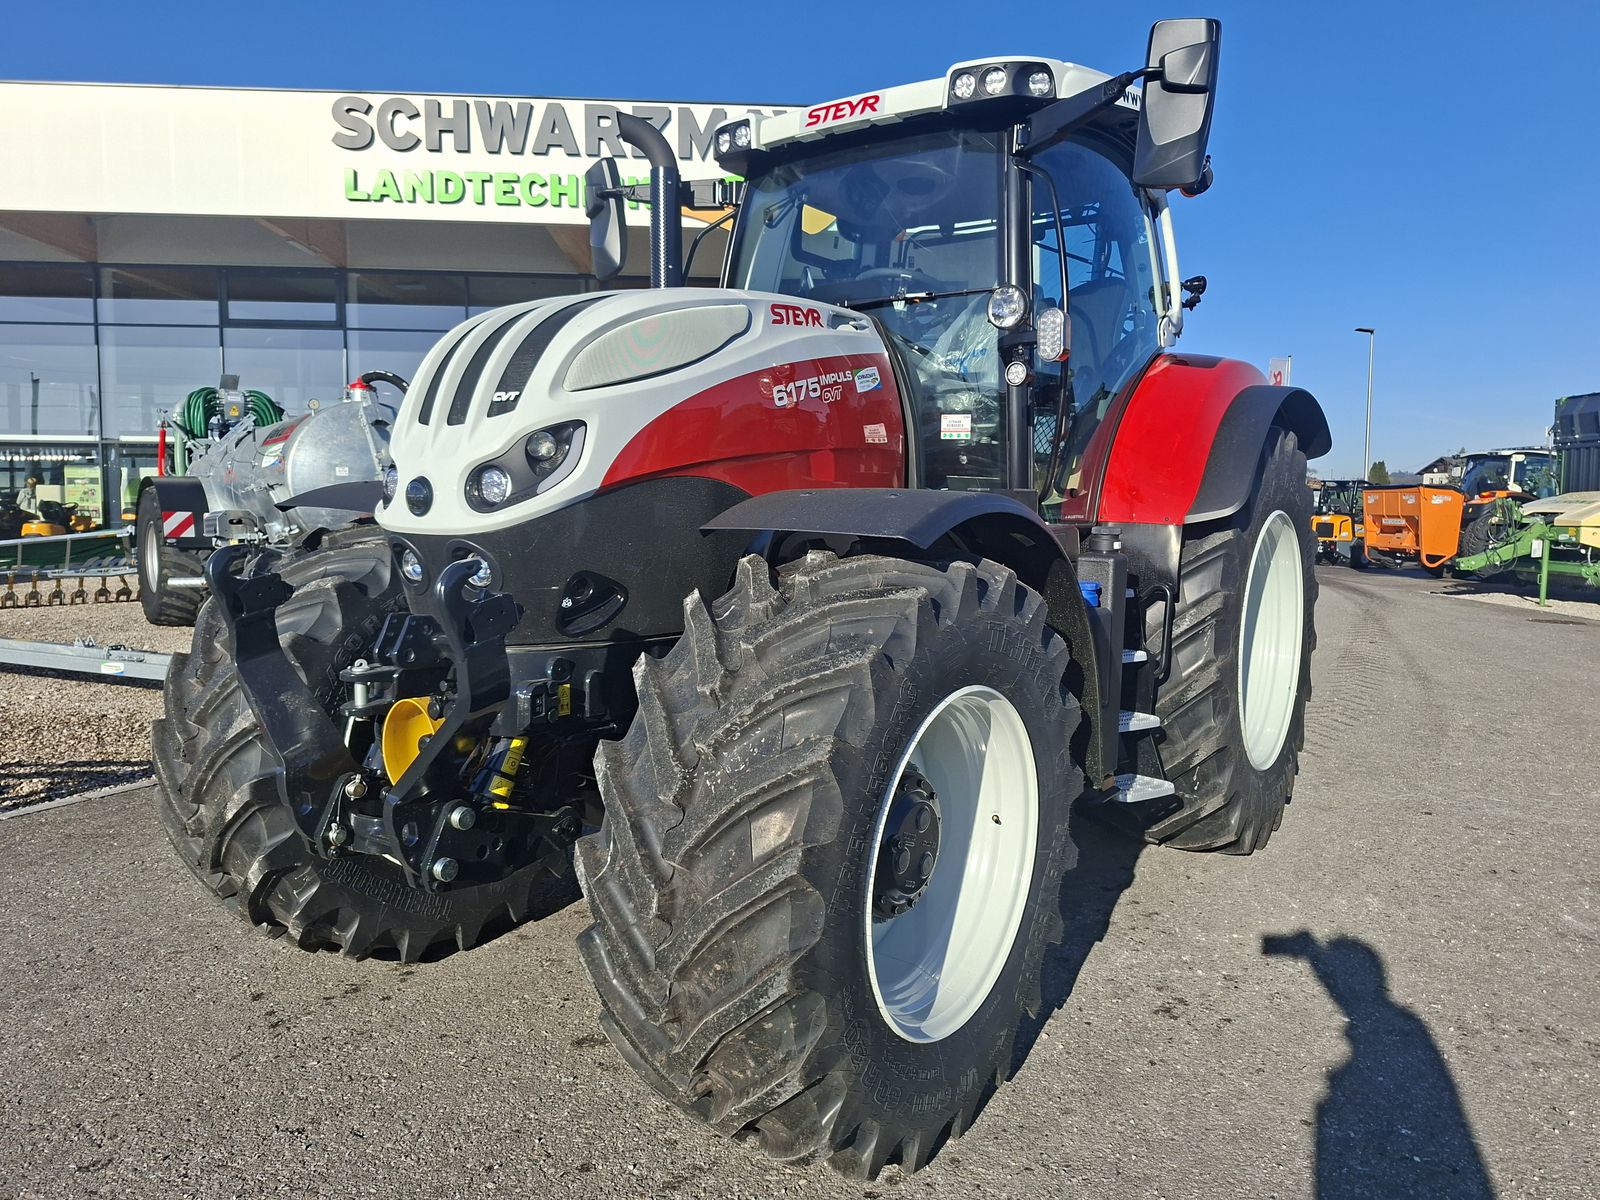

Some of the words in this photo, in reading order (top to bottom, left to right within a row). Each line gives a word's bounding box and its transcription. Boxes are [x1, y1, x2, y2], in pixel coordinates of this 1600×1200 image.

[804, 94, 881, 128] STEYR
[769, 304, 824, 328] STEYR
[493, 391, 520, 402] CVT
[772, 377, 821, 407] 6175
[820, 371, 853, 386] IMPULS
[822, 385, 842, 403] CVT
